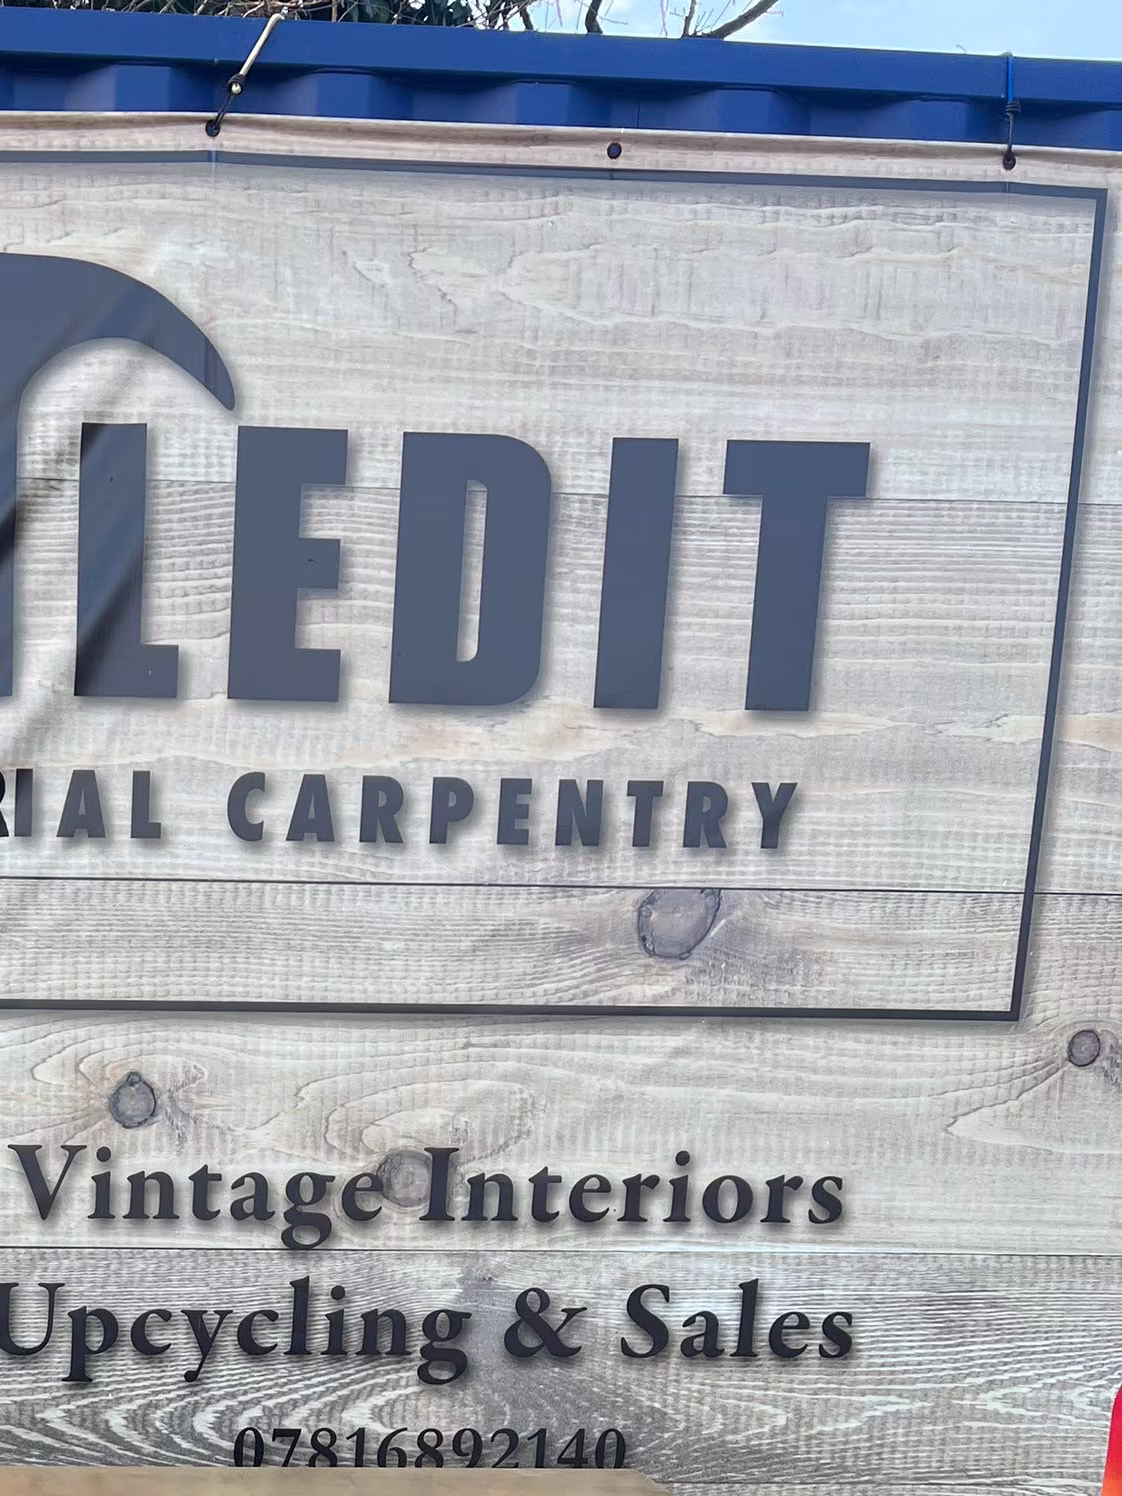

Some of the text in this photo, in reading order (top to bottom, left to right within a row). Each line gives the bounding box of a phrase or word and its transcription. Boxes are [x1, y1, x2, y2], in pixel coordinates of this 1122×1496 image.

[226, 771, 798, 850] CARPENTRY
[8, 1143, 845, 1251] Vintage Interiors
[504, 1287, 588, 1360] &
[620, 1278, 855, 1361] Sales
[233, 1426, 627, 1469] 07816892140
